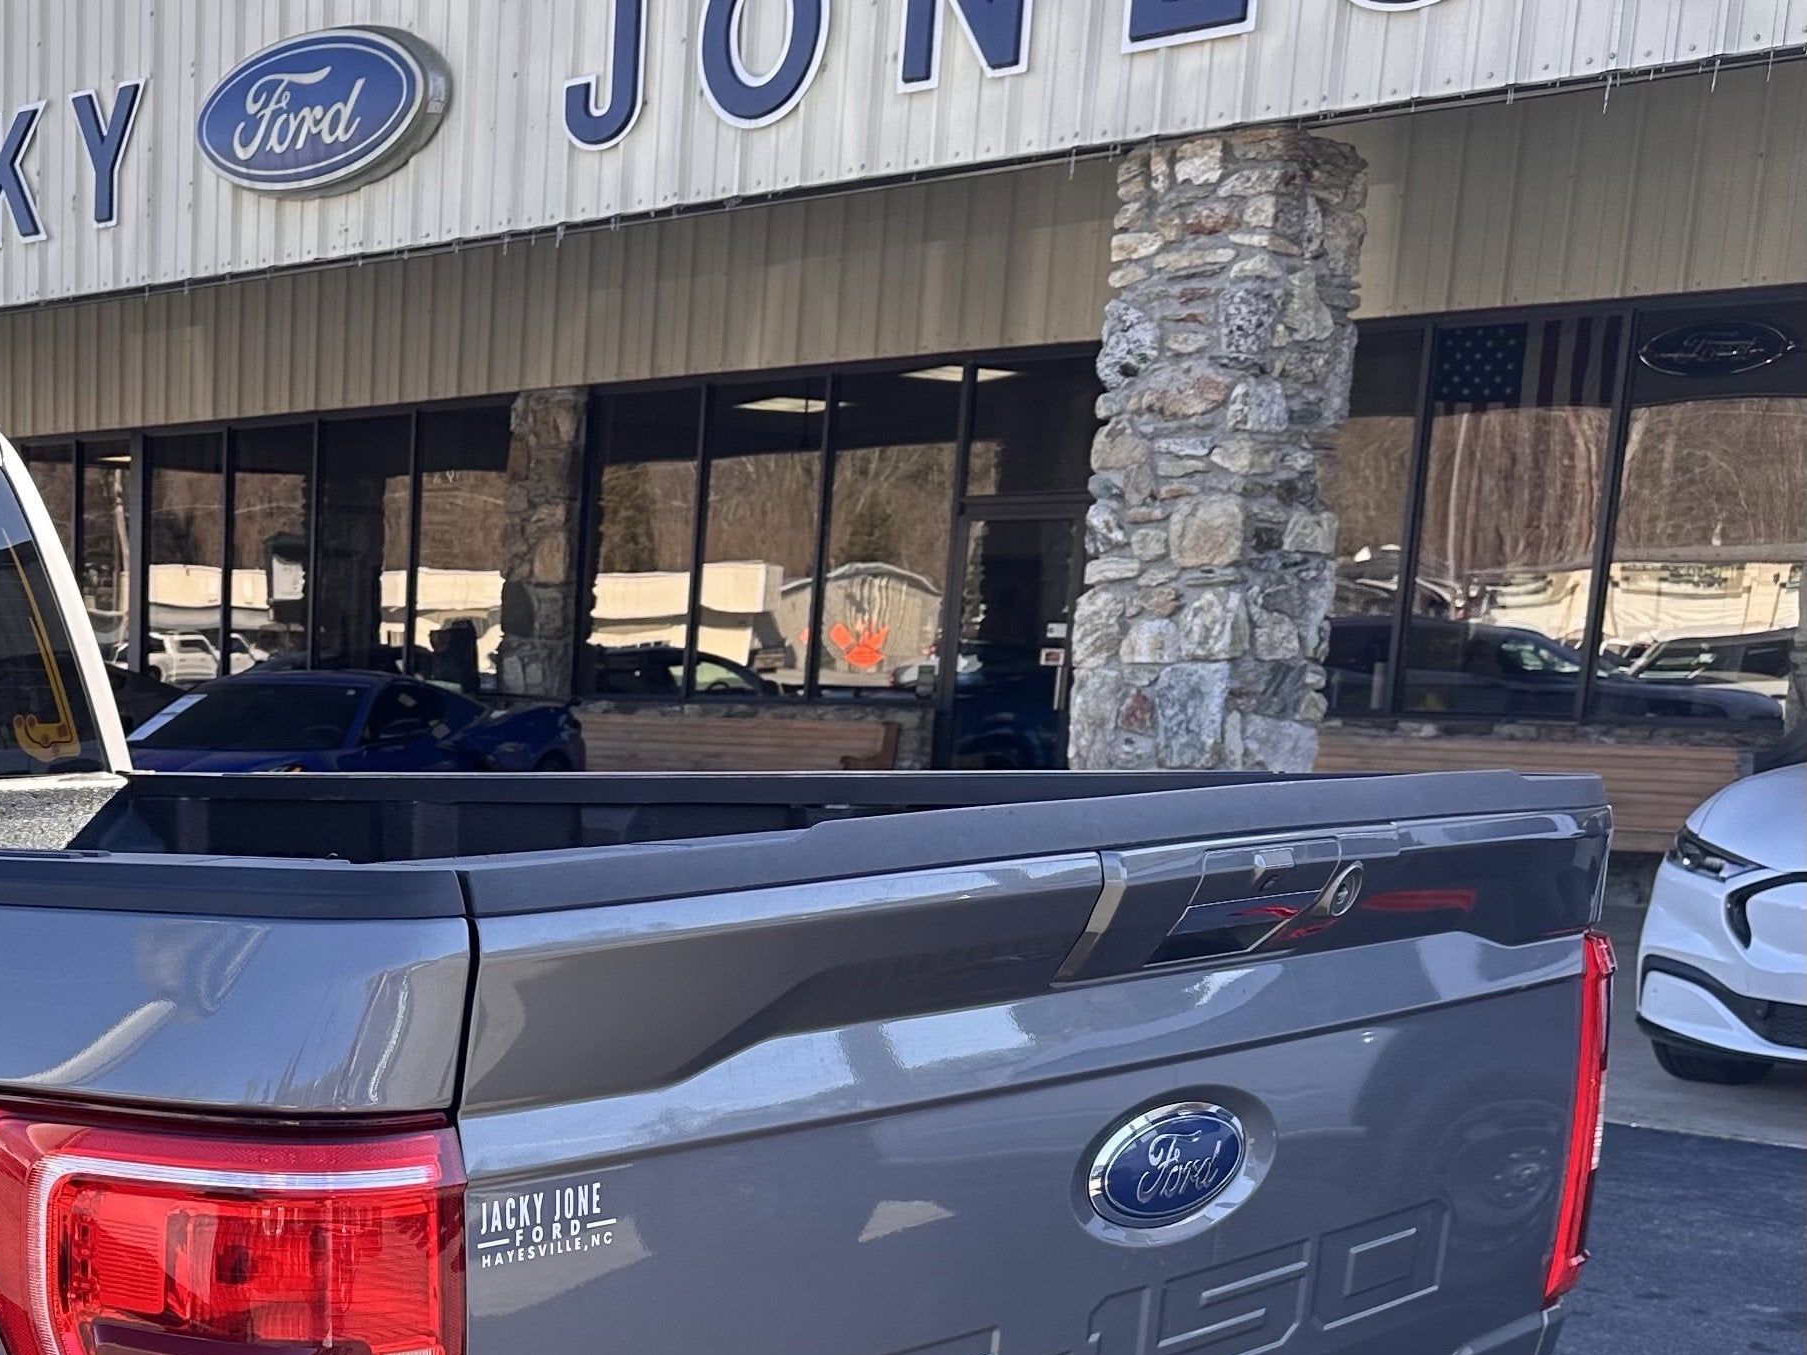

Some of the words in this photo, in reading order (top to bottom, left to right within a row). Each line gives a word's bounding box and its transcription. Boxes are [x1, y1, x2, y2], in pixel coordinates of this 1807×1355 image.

[233, 65, 365, 161] Ford
[1136, 1129, 1221, 1203] Ford
[480, 1192, 544, 1235] JACKY
[554, 1182, 601, 1222] JONE
[515, 1219, 581, 1247] FORD
